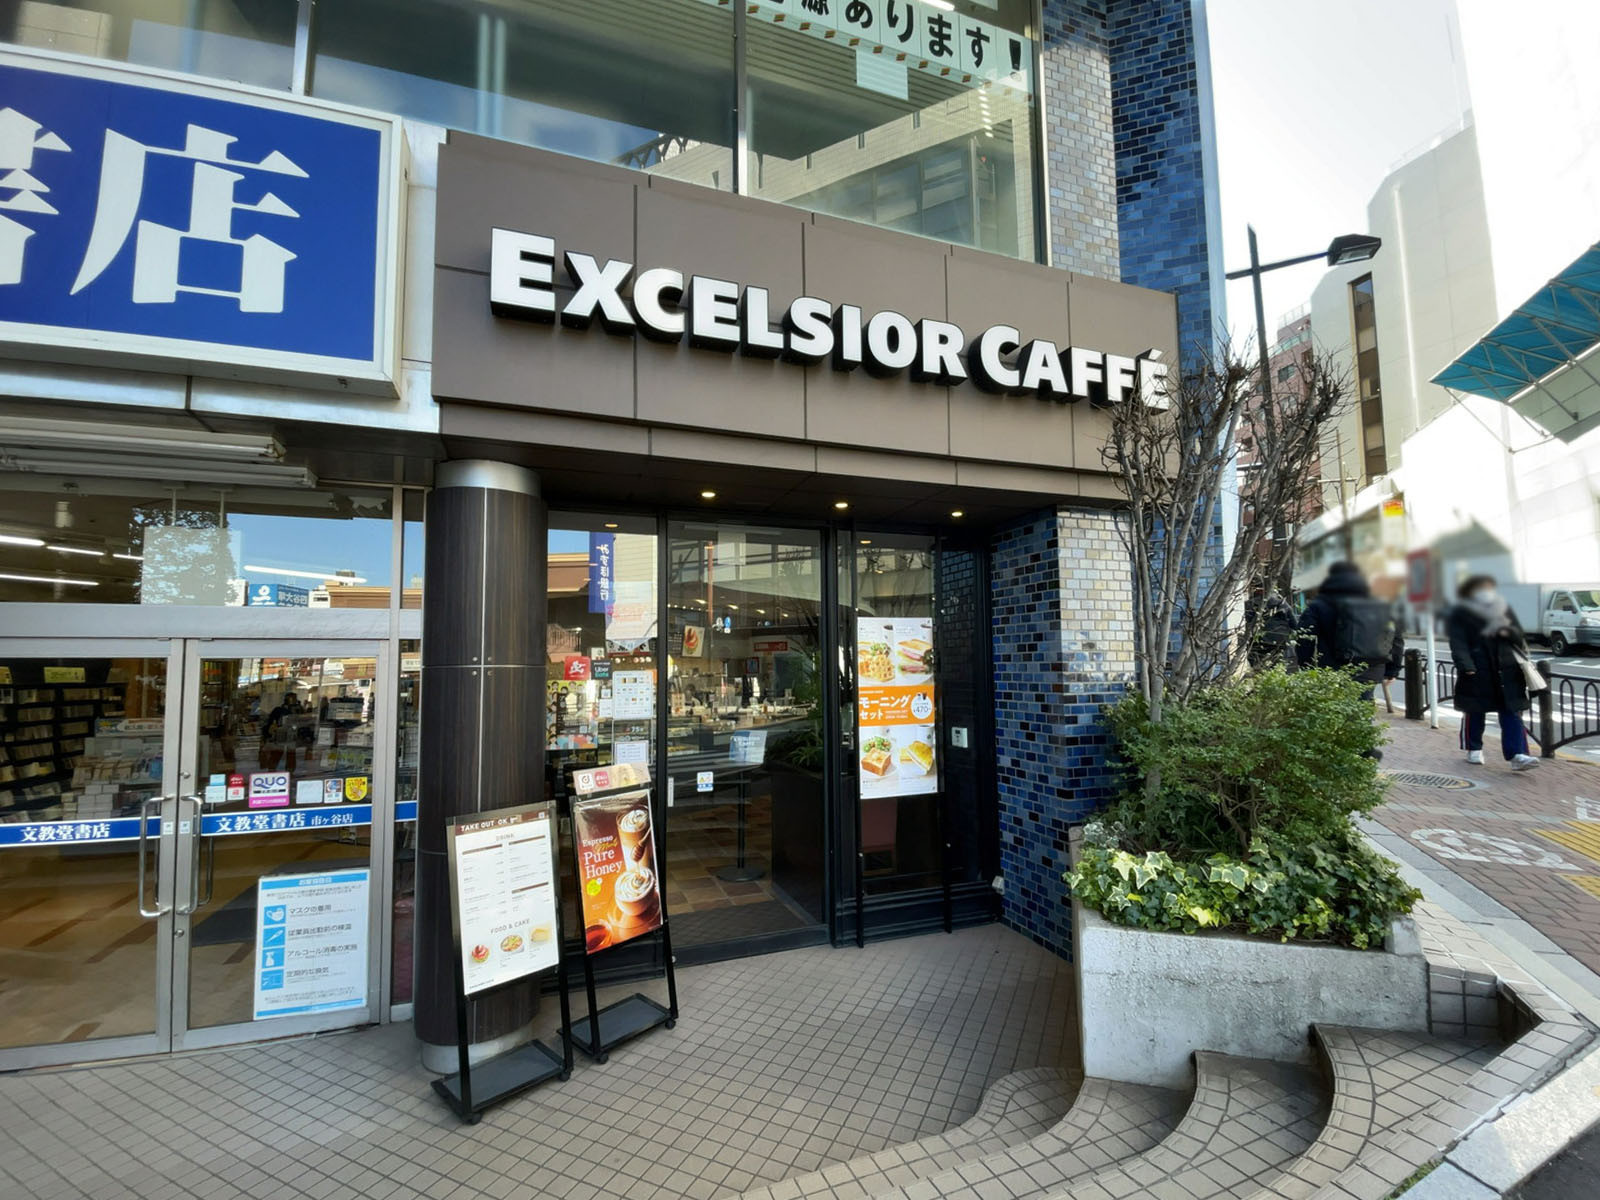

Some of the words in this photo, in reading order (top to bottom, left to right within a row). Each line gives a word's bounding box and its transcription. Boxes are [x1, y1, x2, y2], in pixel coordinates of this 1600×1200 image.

[768, 0, 1022, 81] あります!
[0, 107, 310, 314] 店
[491, 227, 968, 379] EXCELSIOR
[979, 325, 1170, 410] CAFFÉ
[859, 695, 911, 708] モーニング
[860, 709, 883, 721] セット
[253, 776, 287, 789] QUO
[215, 813, 307, 833] 文教堂書店
[461, 822, 480, 832] TAKE
[480, 820, 495, 828] OUT
[497, 817, 508, 825] OK
[20, 822, 111, 842] 文教堂書店
[582, 835, 614, 847] Espresso
[584, 849, 615, 865] Pure
[585, 861, 623, 879] Honey
